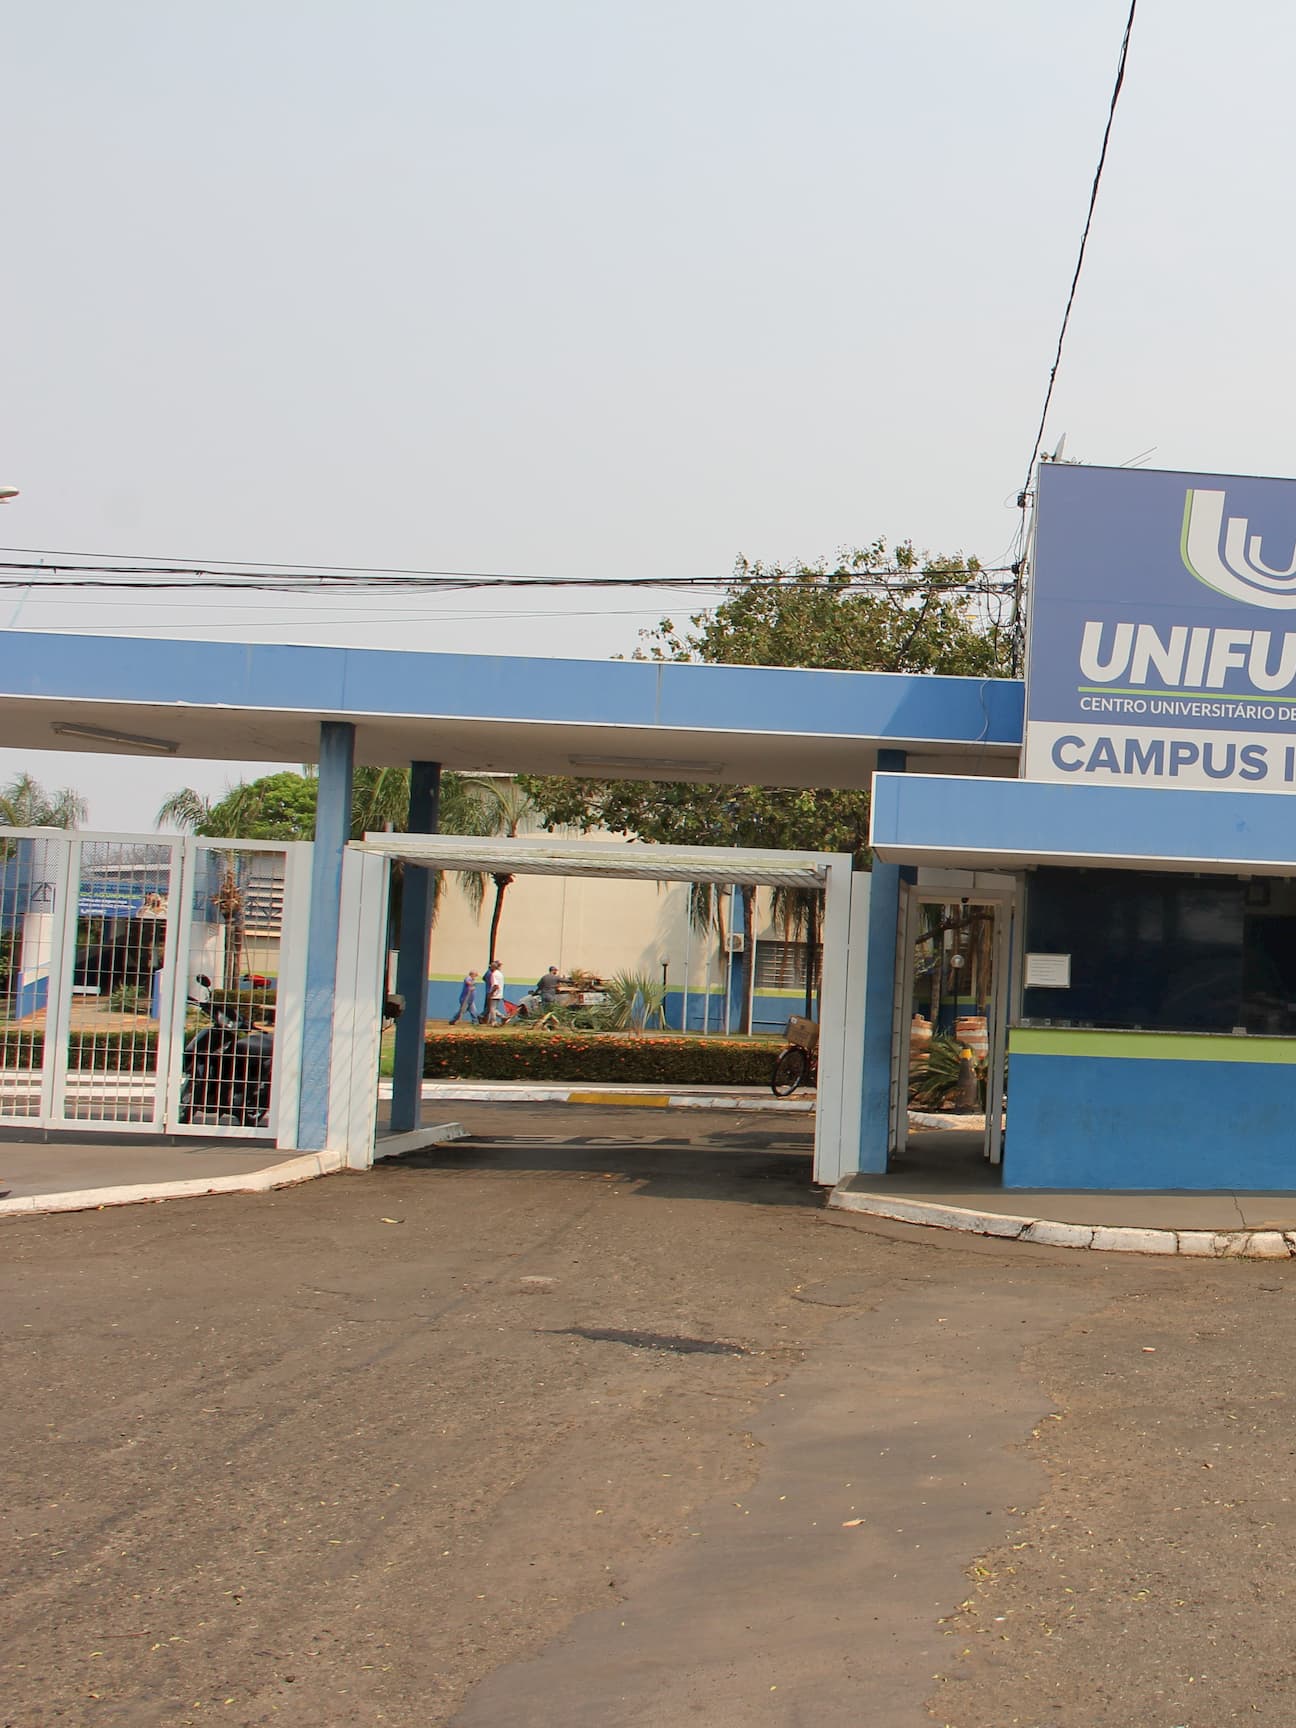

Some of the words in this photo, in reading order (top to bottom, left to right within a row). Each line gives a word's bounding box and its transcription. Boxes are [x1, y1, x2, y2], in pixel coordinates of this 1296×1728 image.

[1080, 697, 1147, 713] CENTRO
[1150, 700, 1275, 720] UNIVERSITÁRIO
[1051, 735, 1268, 781] CAMPUS
